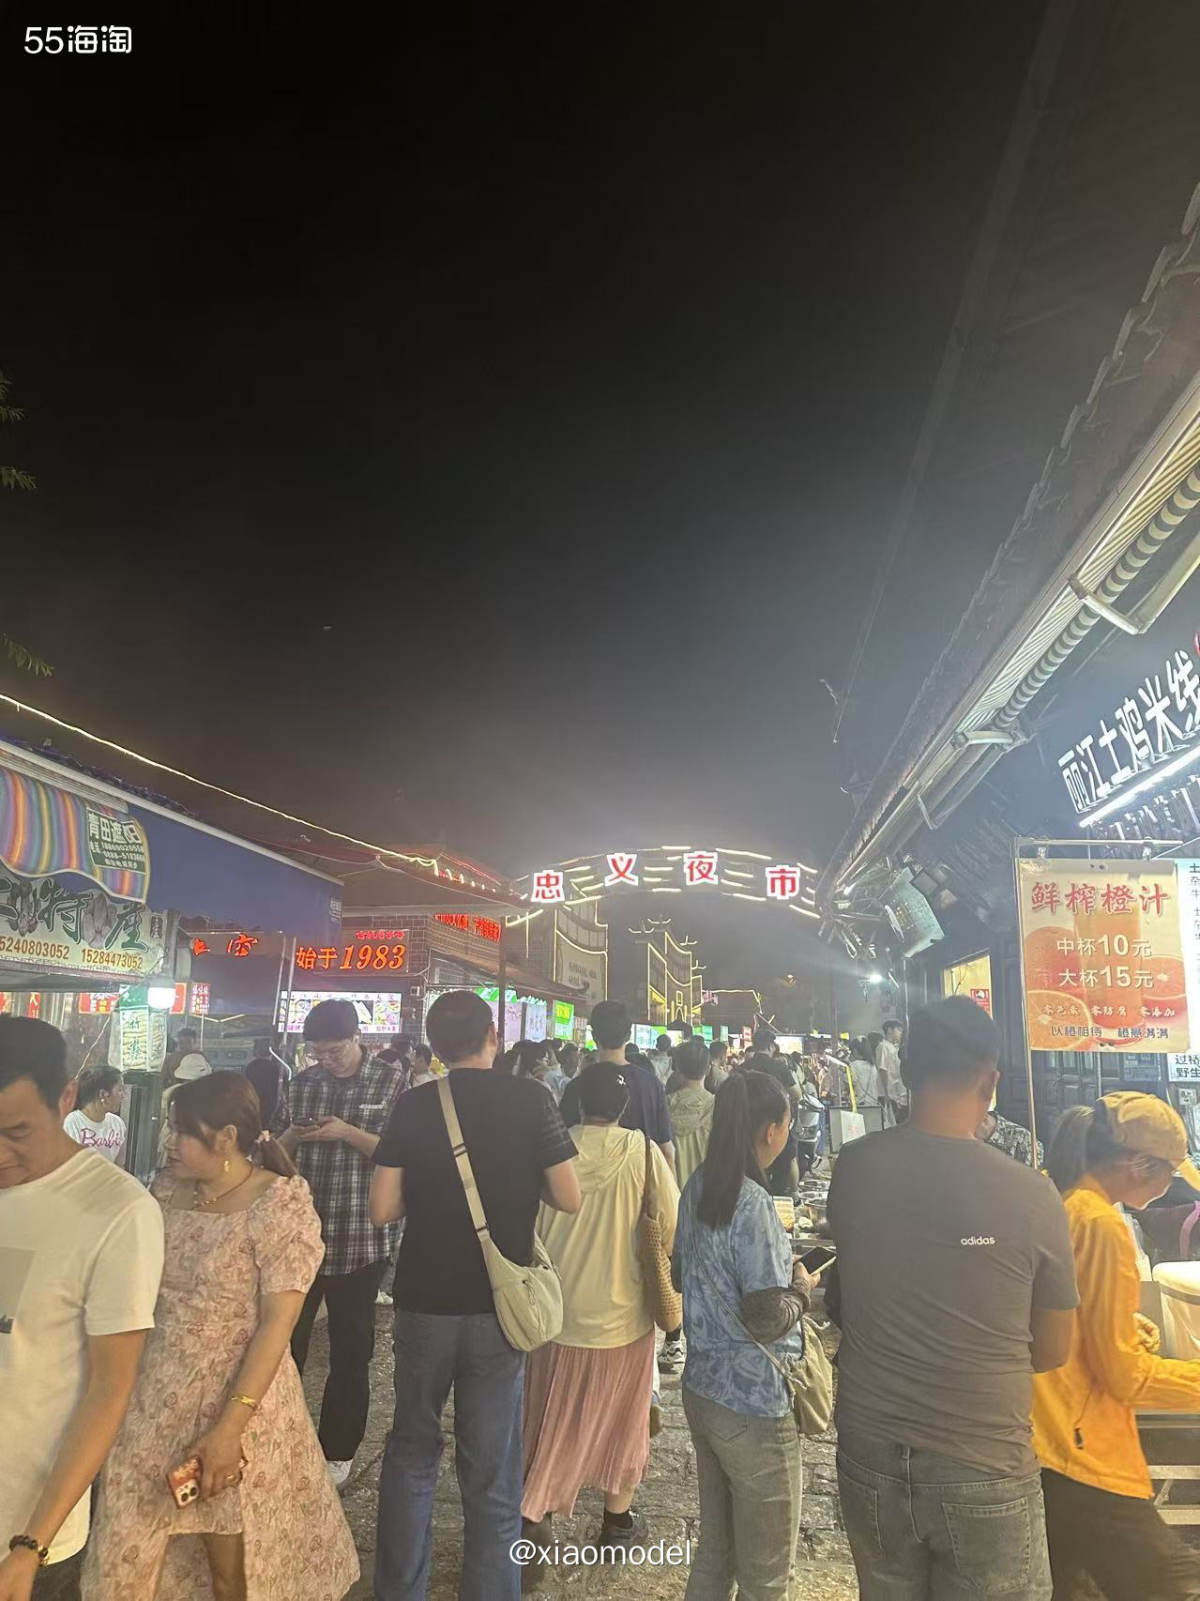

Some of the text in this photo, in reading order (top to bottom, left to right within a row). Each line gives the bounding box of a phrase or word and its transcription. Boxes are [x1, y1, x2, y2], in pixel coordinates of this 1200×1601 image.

[1058, 650, 1200, 813] 丽江土鸡米线
[531, 850, 801, 904] 忠义夜市
[1032, 882, 1169, 917] 鲜榨橙汁
[295, 944, 407, 971] 始于1983
[1057, 934, 1152, 958] 中杯10元
[81, 949, 144, 970] 15284473052
[1059, 965, 1154, 988] 大杯15元
[80, 1128, 121, 1149] Barbi
[960, 1235, 996, 1246] adidas
